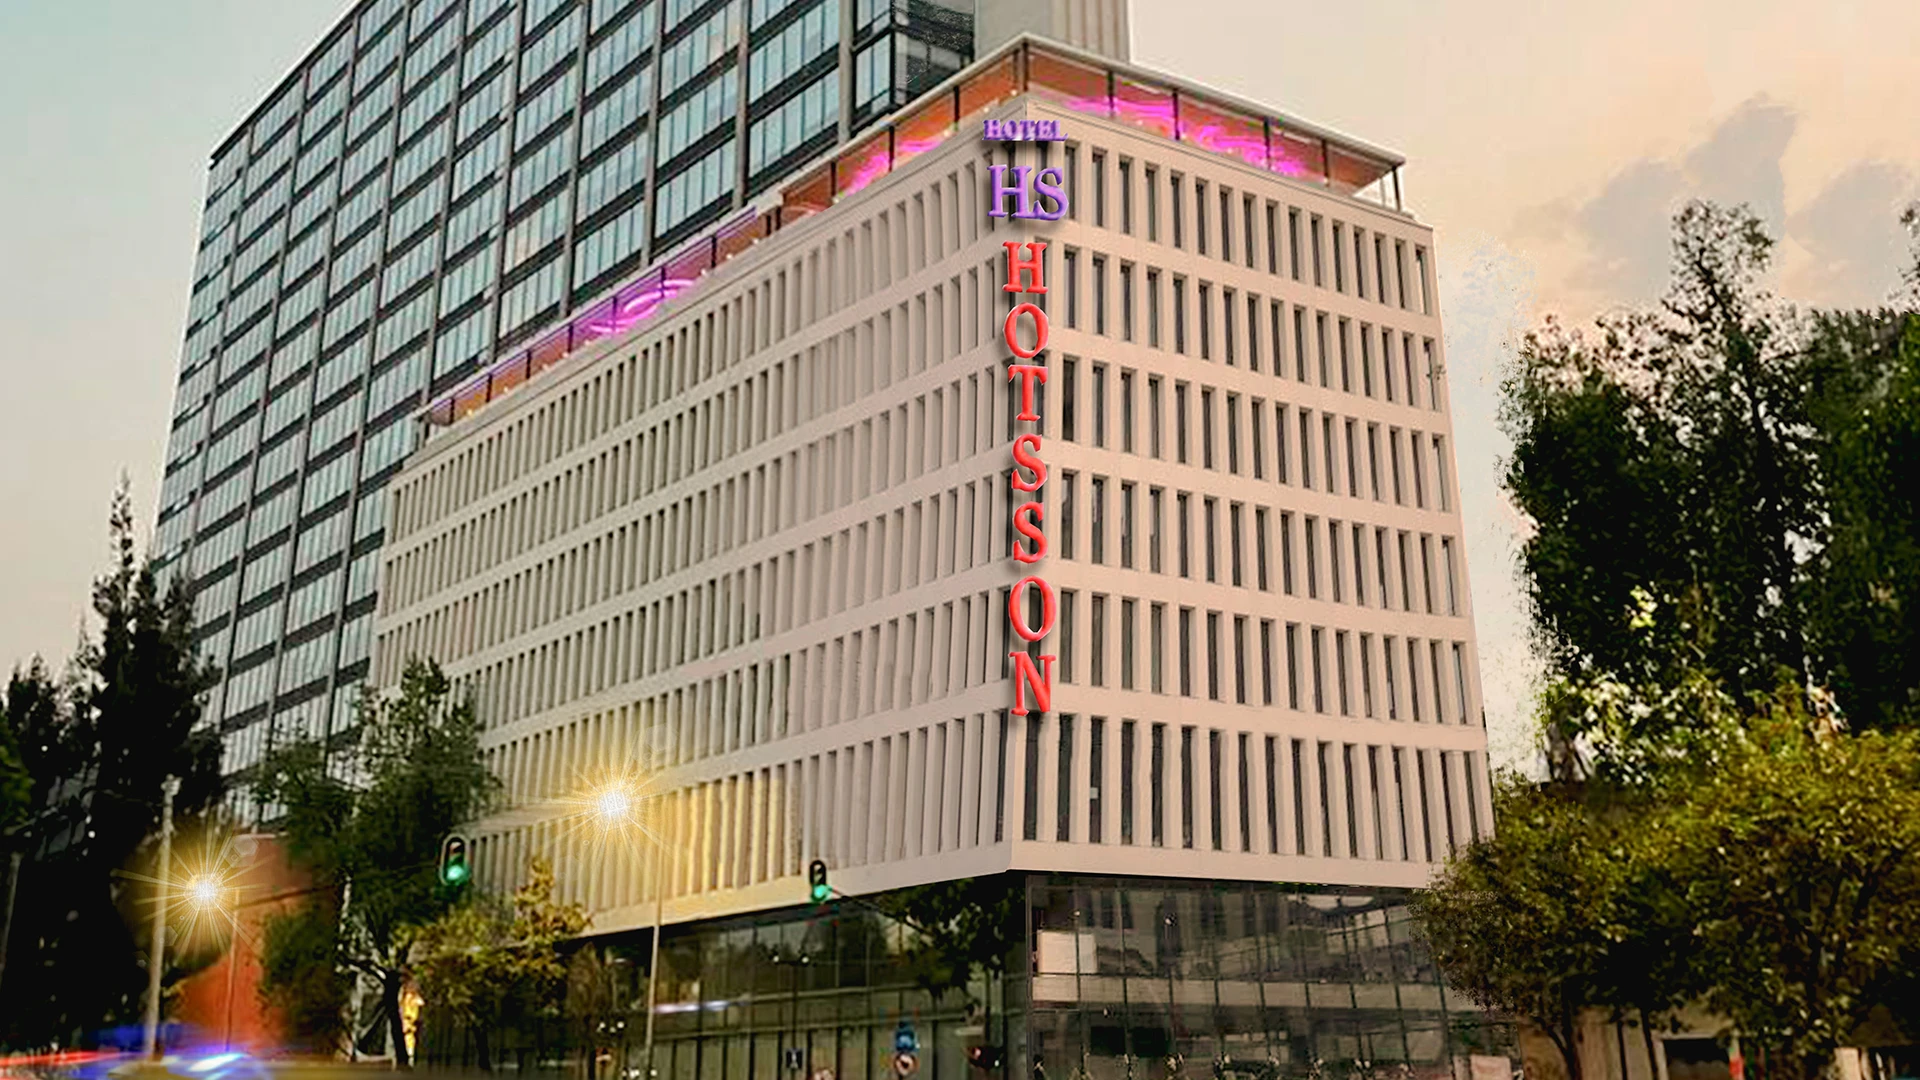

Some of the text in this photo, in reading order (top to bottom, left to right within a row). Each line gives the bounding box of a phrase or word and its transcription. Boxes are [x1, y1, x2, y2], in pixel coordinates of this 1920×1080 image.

[983, 119, 1068, 141] HOTEL
[987, 164, 1069, 221] HS
[1002, 241, 1056, 717] HOTSSON
